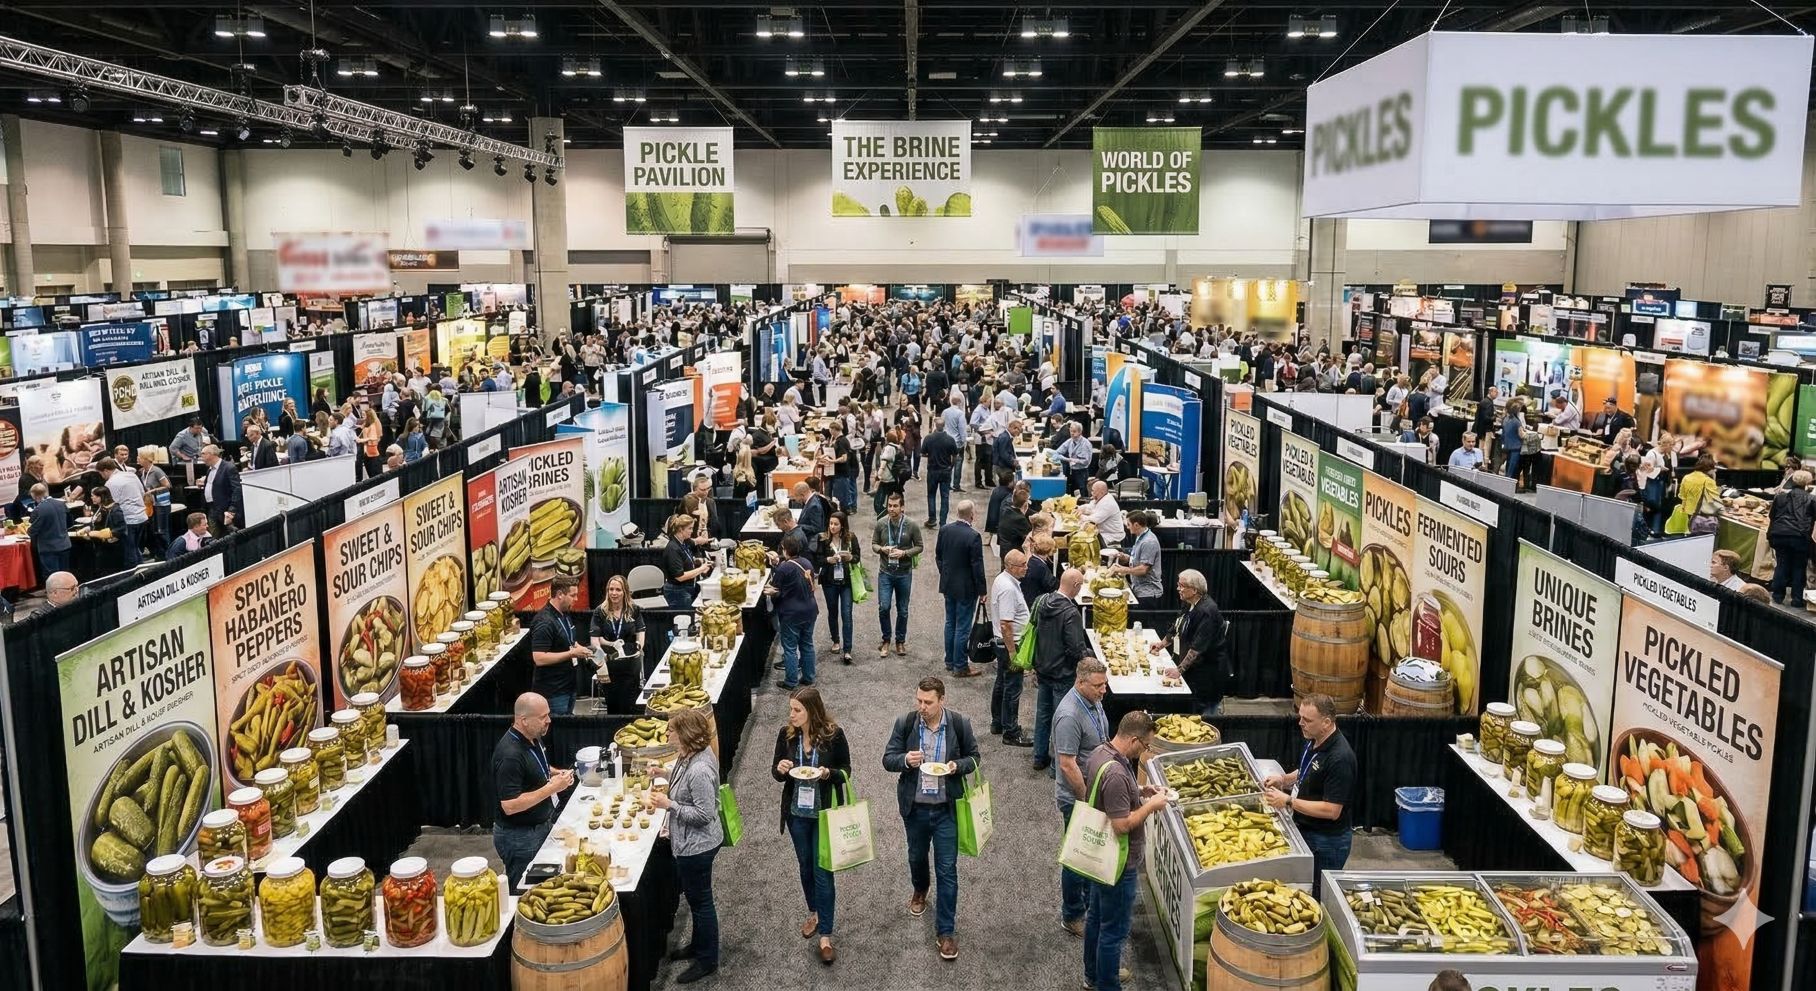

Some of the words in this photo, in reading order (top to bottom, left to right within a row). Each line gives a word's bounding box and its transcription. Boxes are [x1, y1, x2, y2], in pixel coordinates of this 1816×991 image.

[1311, 92, 1413, 178] PICKLES
[1456, 84, 1777, 160] PICKLES
[640, 142, 719, 164] PICKLE
[843, 136, 885, 158] THE
[892, 136, 961, 158] BRINE
[1101, 151, 1164, 169] WORLD
[1169, 151, 1193, 169] OF
[633, 167, 725, 187] PAVILION
[843, 162, 961, 181] EXPERIENCE
[1101, 172, 1192, 193] PICKLES
[499, 468, 527, 498] ARTISAN
[528, 451, 574, 472] ICKLED
[416, 493, 446, 527] SWEET
[449, 490, 455, 509] &
[501, 487, 528, 515] KOSHER
[1320, 475, 1359, 509] VEGETABLES
[1365, 490, 1411, 538] PICKLES
[340, 526, 380, 566] SWEET
[383, 522, 393, 545] &
[410, 524, 436, 554] SOUR
[437, 509, 463, 539] CHIPS
[1417, 512, 1482, 564] FERMENTED
[333, 563, 367, 599] SOUR
[369, 543, 403, 579] CHIPS
[1429, 544, 1466, 584] SOURS
[138, 587, 165, 610] ARTISAN
[180, 578, 186, 590] &
[186, 567, 210, 587] KOSHER
[234, 569, 279, 612] SPICY
[284, 563, 295, 587] &
[1534, 566, 1598, 627] UNIQUE
[1633, 572, 1658, 594] PICKLED
[1658, 583, 1697, 613] VEGETABLES
[225, 583, 307, 645] HABANERO
[1532, 599, 1595, 660] BRINES
[96, 625, 185, 698] ARTISAN
[235, 611, 303, 668] PEPPERS
[1644, 625, 1741, 703] PICKLED
[72, 700, 118, 747] DILL
[122, 689, 137, 720] &
[141, 650, 207, 710] KOSHER
[1624, 650, 1764, 761] VEGETABLES
[93, 730, 124, 754] ARTISAN
[125, 722, 141, 736] DILL
